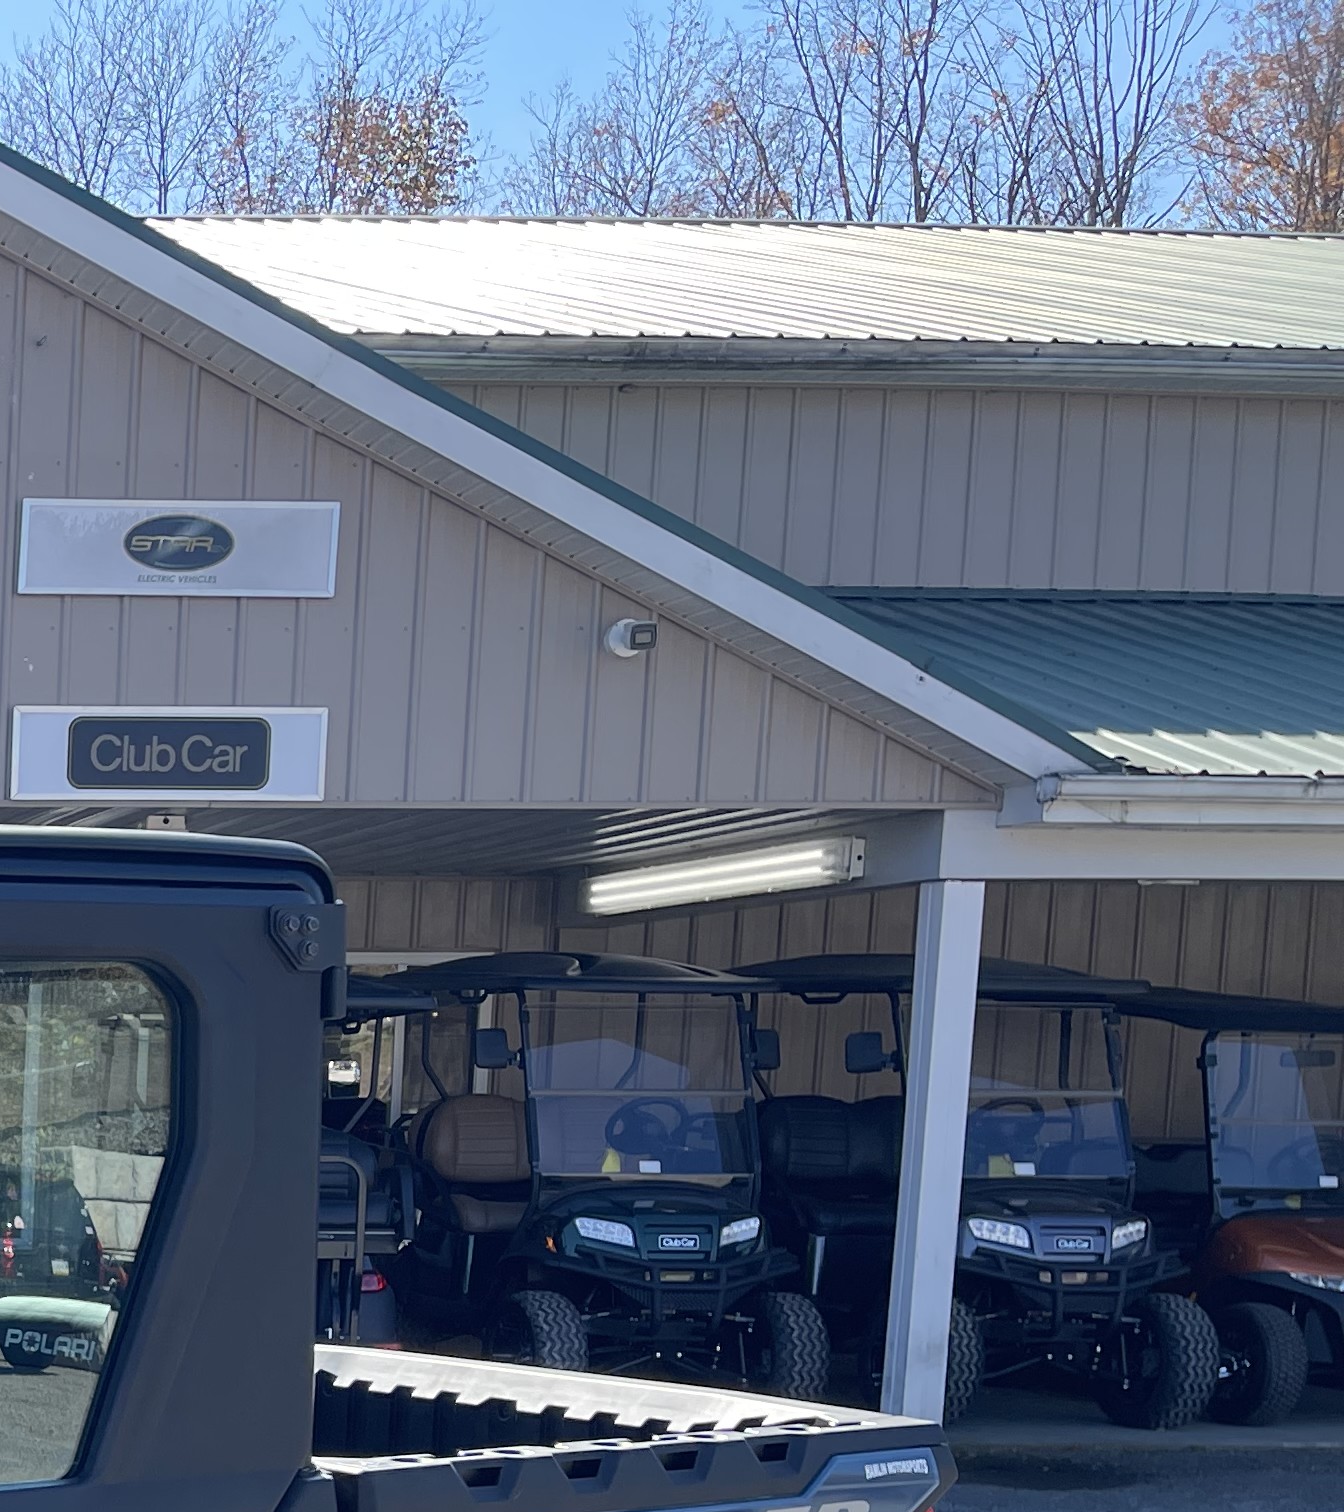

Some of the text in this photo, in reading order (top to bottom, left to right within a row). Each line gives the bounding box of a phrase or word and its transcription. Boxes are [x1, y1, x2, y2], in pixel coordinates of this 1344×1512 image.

[129, 535, 214, 553] STAR
[137, 574, 217, 585] ELECTRIC VEHICLES
[4, 1327, 97, 1362] POLARI
